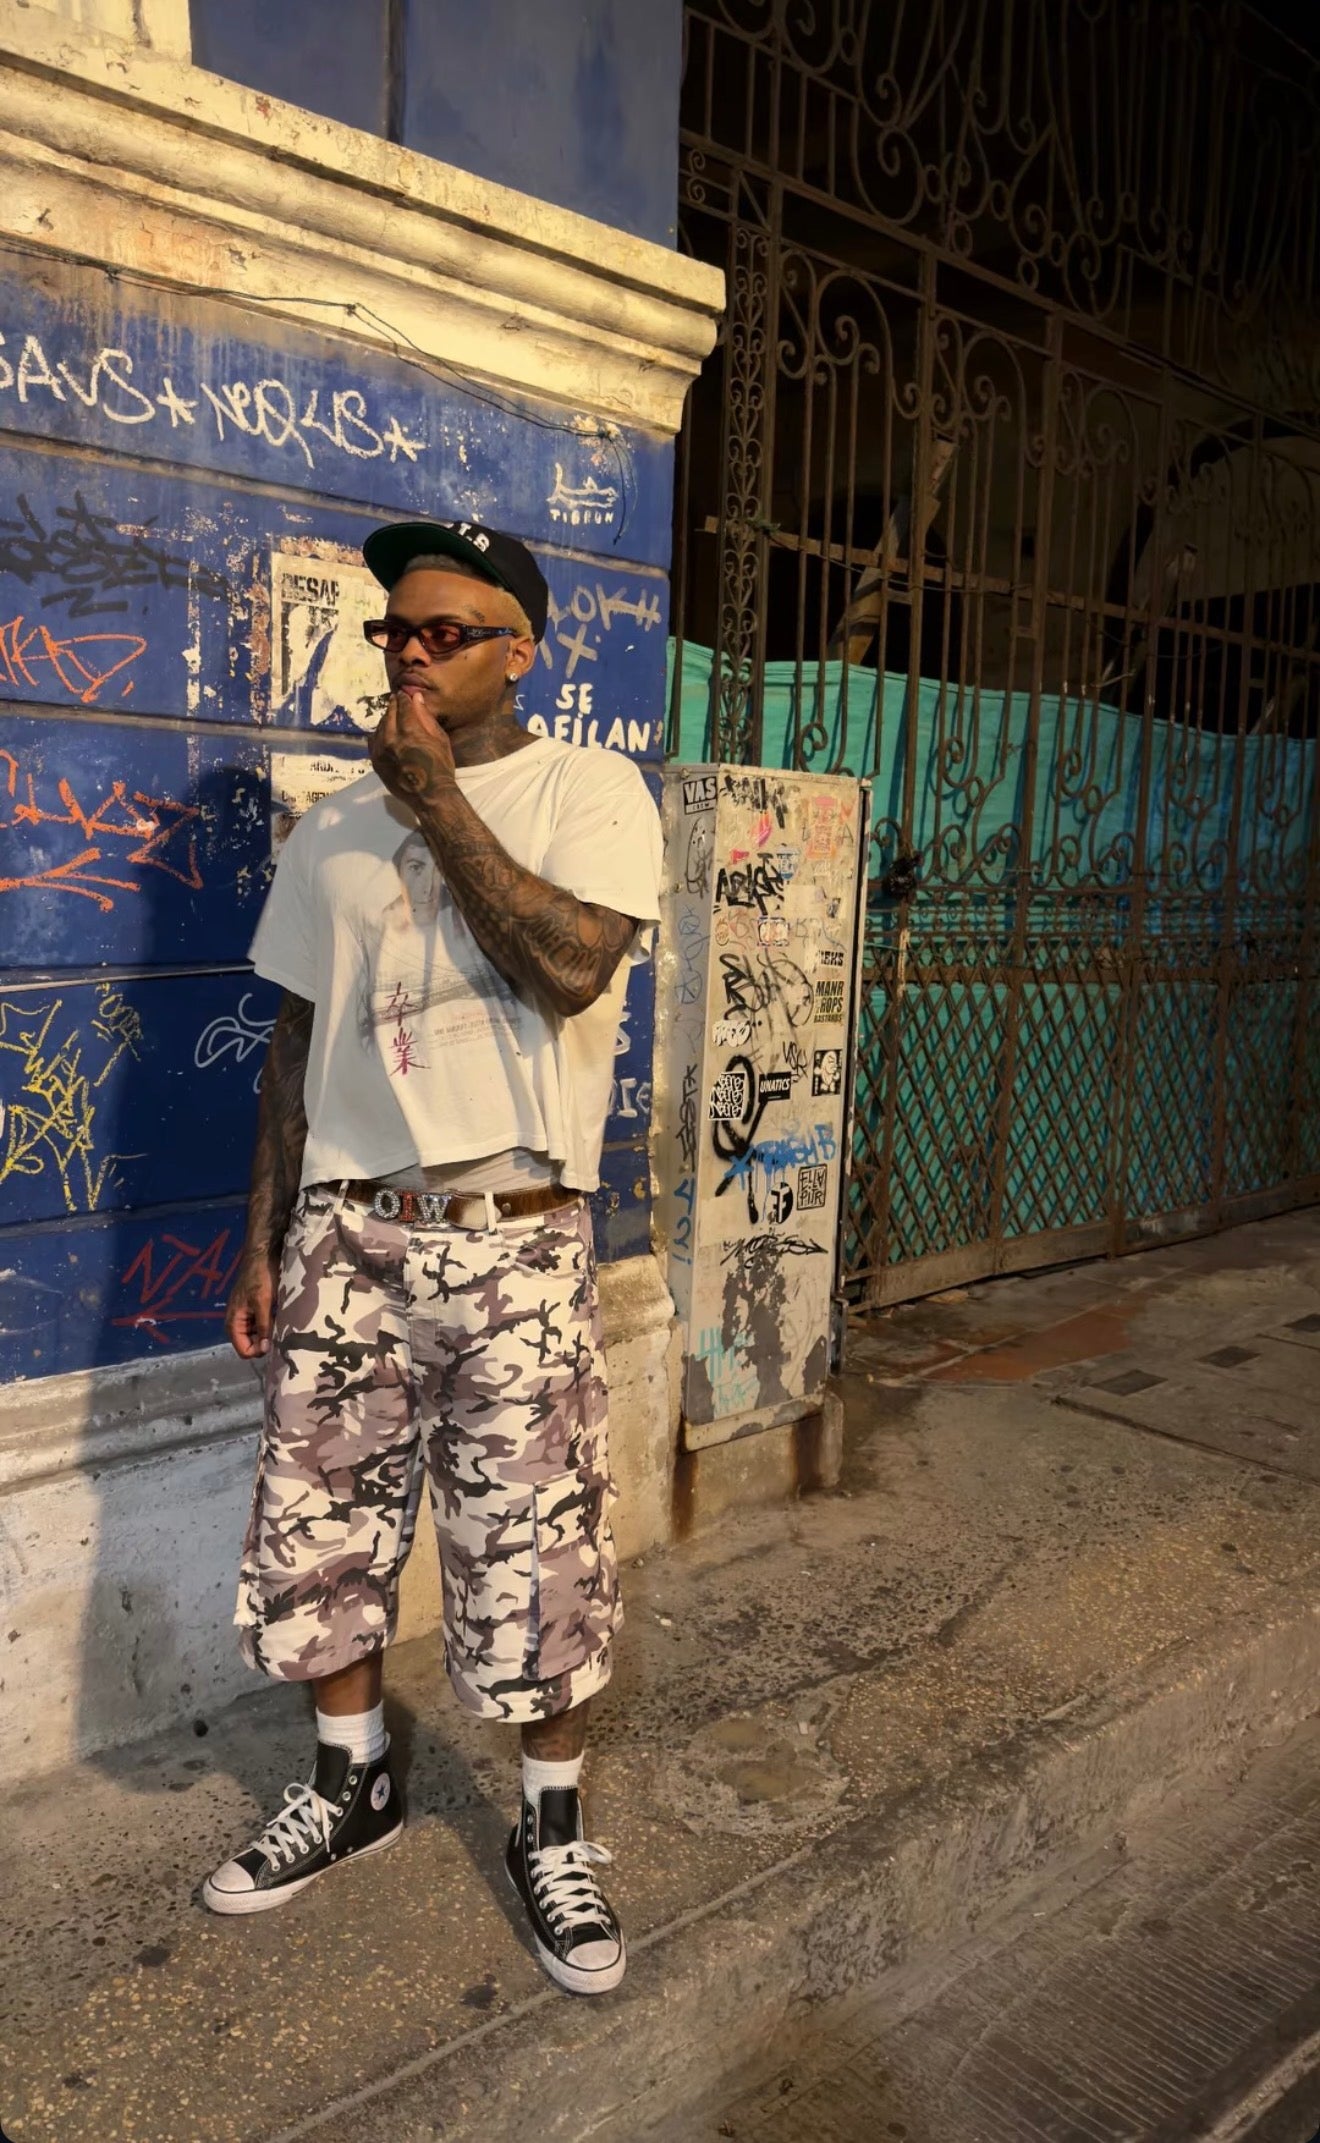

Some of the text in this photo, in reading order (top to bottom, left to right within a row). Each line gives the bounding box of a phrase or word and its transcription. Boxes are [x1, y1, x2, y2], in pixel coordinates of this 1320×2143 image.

[555, 682, 593, 715] SE
[684, 777, 717, 804] VAS
[384, 981, 431, 1077] 卒業
